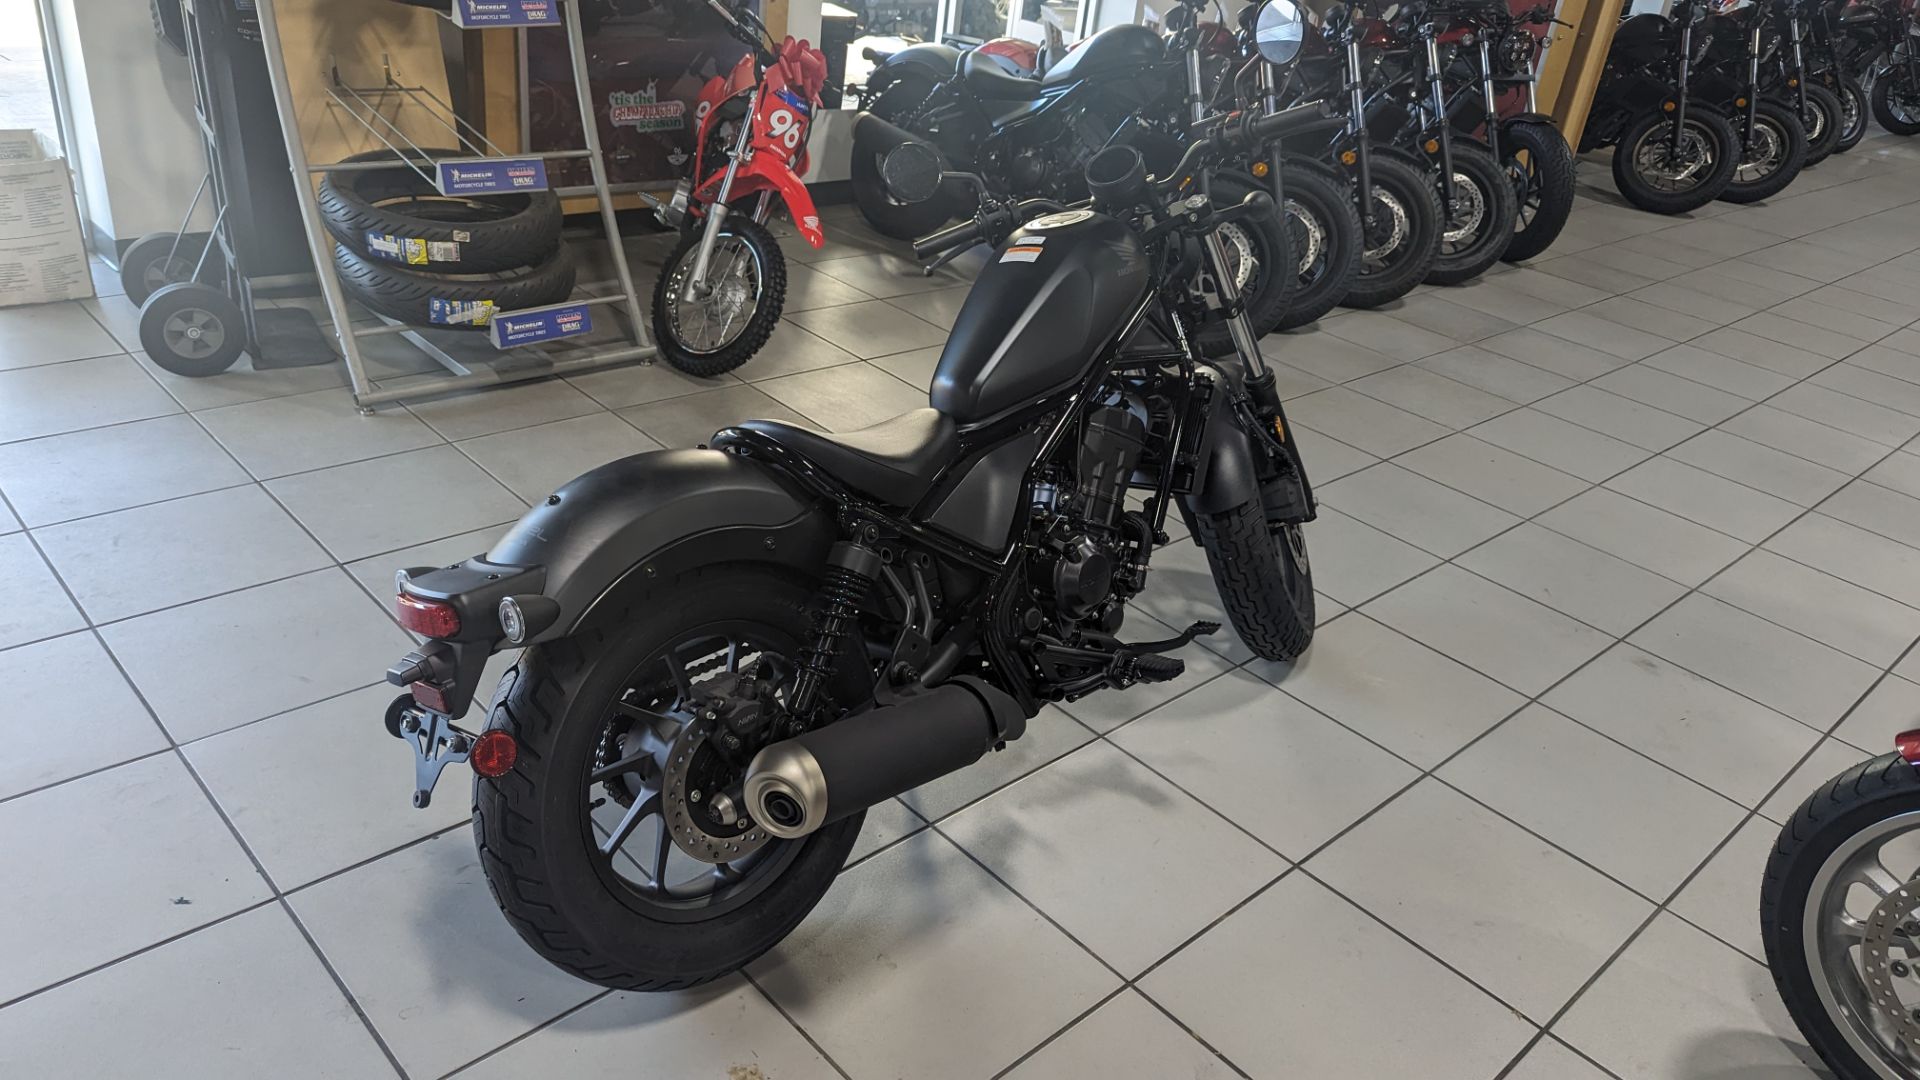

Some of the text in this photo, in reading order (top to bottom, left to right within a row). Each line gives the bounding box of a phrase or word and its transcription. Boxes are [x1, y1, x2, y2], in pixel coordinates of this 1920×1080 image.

[633, 91, 655, 105] the
[639, 117, 681, 130] season
[767, 109, 801, 149] 96
[513, 177, 533, 185] DRAG
[513, 321, 543, 330] MICHELIN
